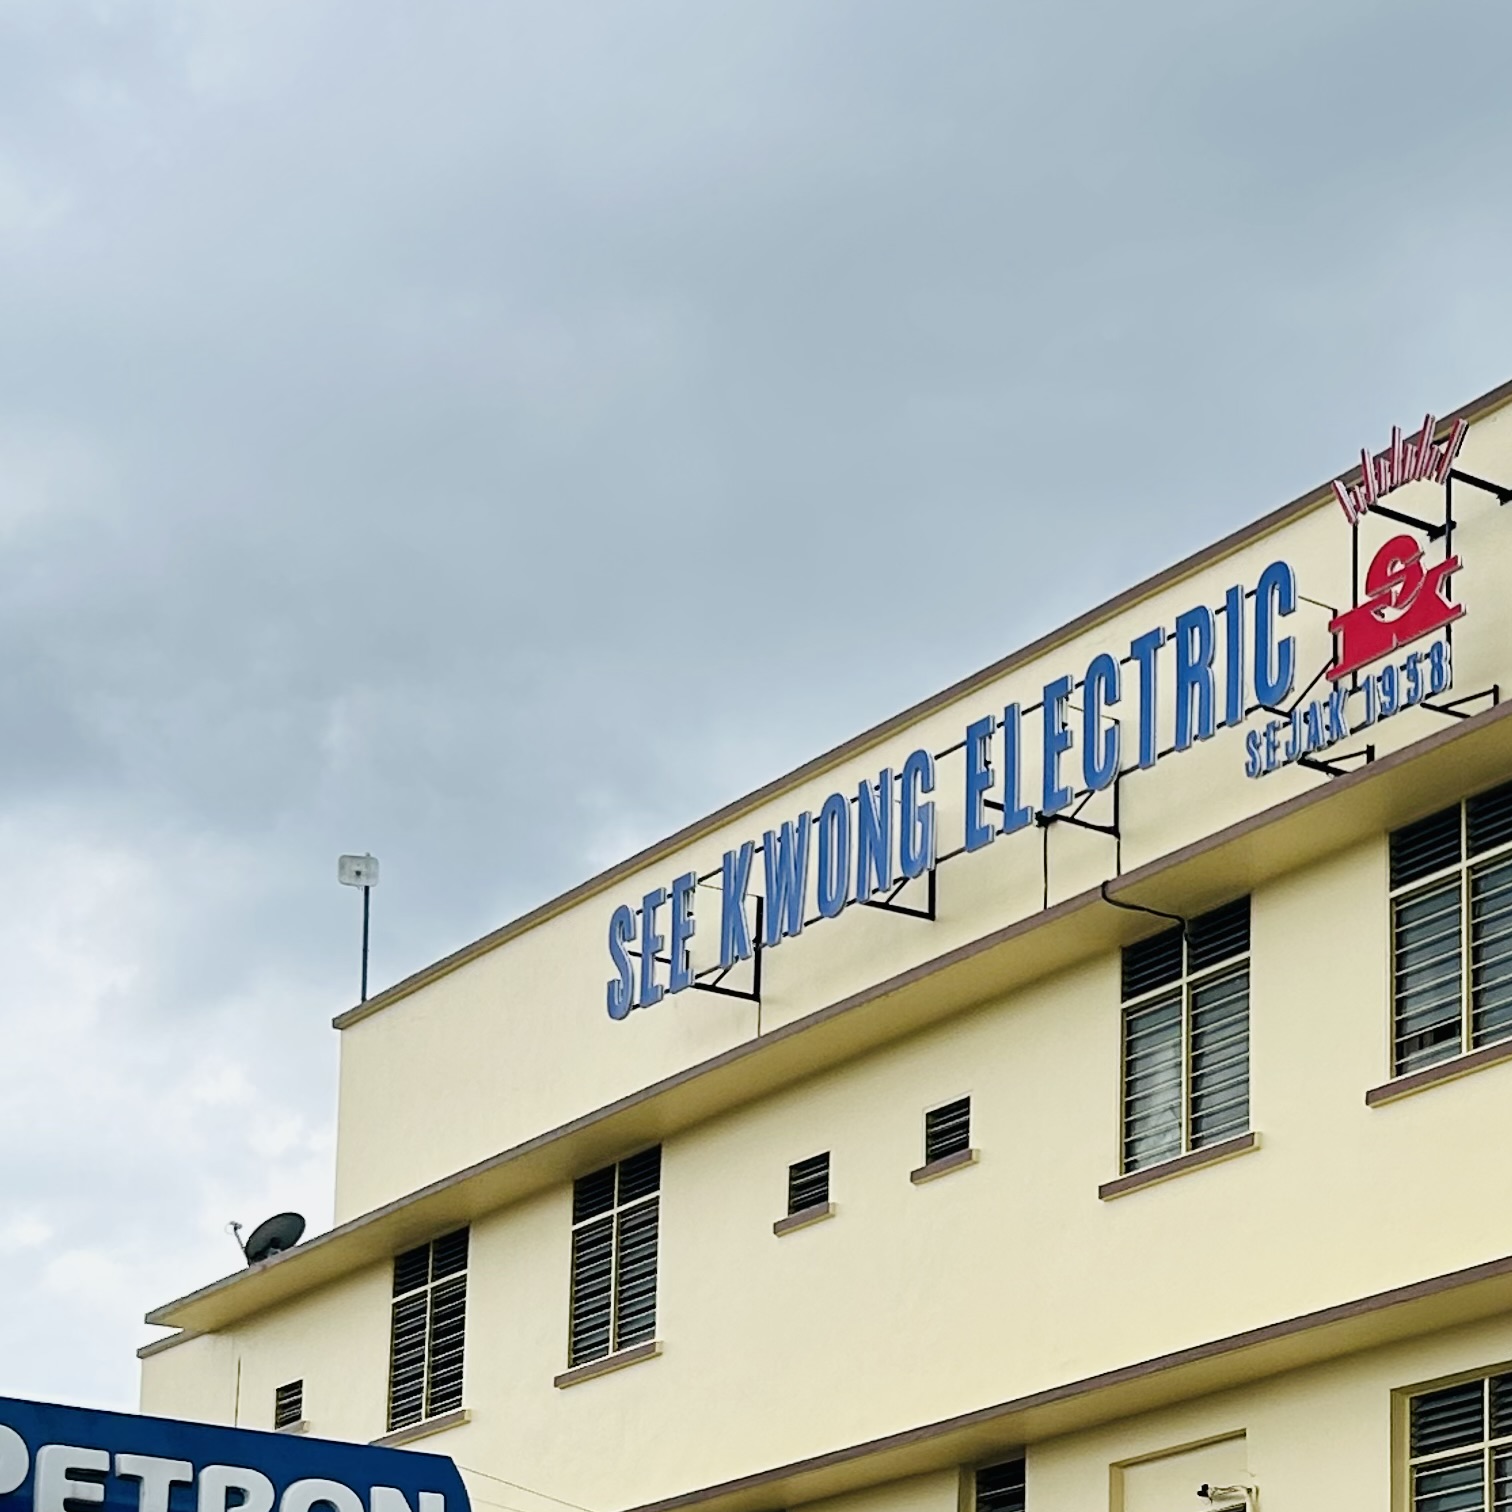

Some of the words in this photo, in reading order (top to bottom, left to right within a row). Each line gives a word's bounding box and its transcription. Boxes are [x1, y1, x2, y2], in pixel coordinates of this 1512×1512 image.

[607, 871, 699, 1020] SEE
[720, 748, 936, 968] KWONG
[964, 560, 1298, 853] ELECTRIC
[1244, 687, 1349, 780] SEJAK
[1361, 640, 1451, 725] 1958
